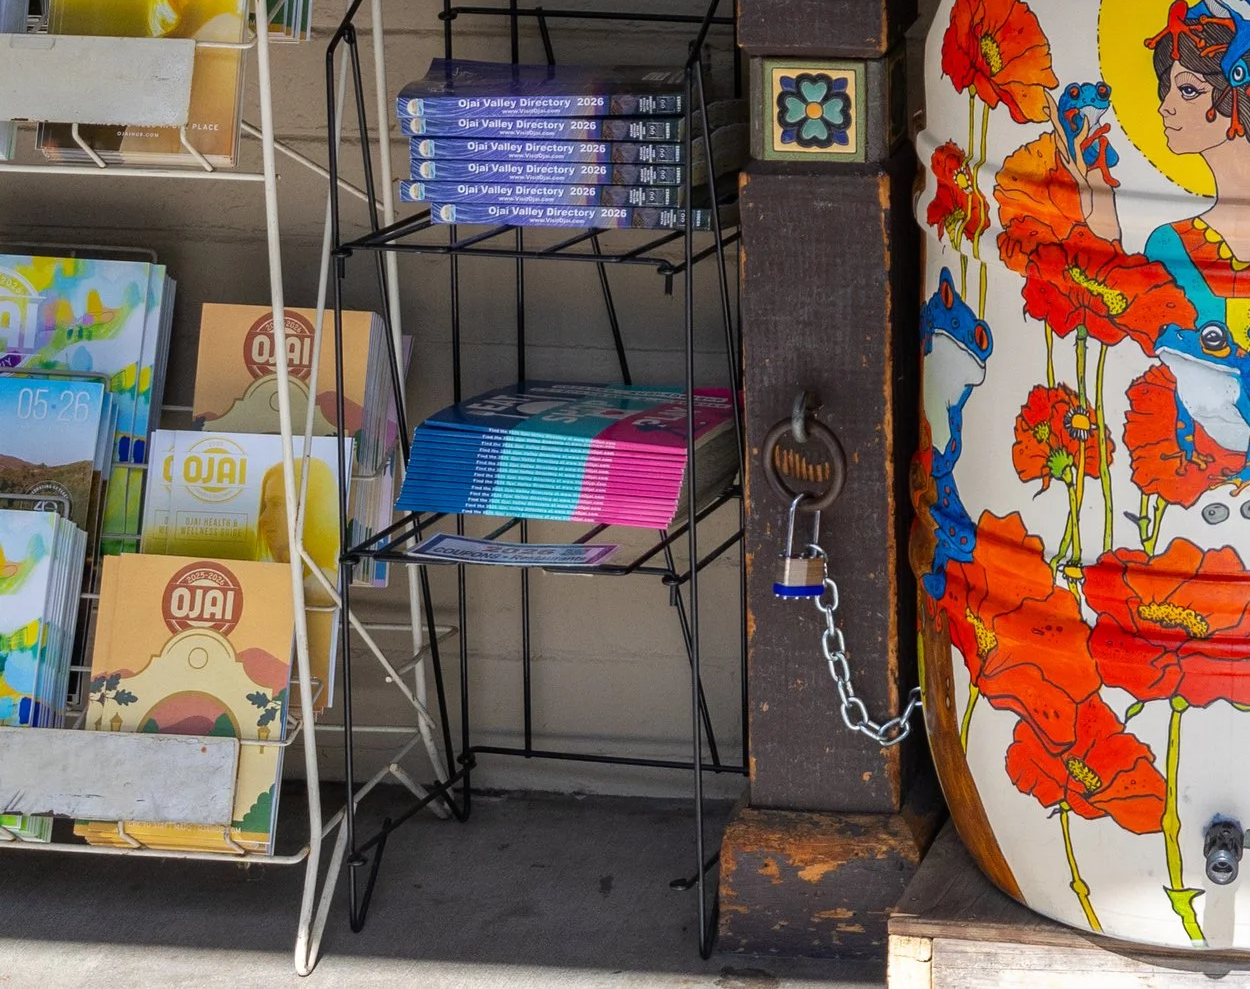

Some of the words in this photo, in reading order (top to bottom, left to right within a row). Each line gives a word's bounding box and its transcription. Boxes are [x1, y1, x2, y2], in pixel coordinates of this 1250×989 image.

[458, 99, 480, 108] Ojai
[483, 99, 516, 108] Valley
[520, 97, 571, 108] Directory
[577, 97, 604, 106] 2026
[192, 123, 219, 131] PLACE
[458, 119, 479, 128] Ojai
[481, 119, 513, 129] Valley
[516, 120, 565, 130] Directory
[570, 121, 597, 130] 2026
[467, 141, 488, 151] Ojai
[490, 142, 522, 152] Valley
[525, 143, 574, 154] Directory
[580, 144, 606, 153] 2026
[468, 163, 489, 172] Ojai
[491, 164, 523, 174] Valley
[526, 164, 575, 175] Directory
[581, 166, 607, 174] 2026
[457, 185, 478, 194] Ojai
[480, 185, 512, 196] Valley
[516, 186, 564, 197] Directory
[570, 187, 596, 196] 2026
[488, 206, 509, 216] Ojai
[511, 207, 543, 217] Valley
[547, 207, 596, 219] Directory
[601, 209, 627, 218] 2026
[183, 455, 247, 485] OJAI
[186, 571, 225, 586] 2025-2026
[170, 587, 235, 620] OJAI
